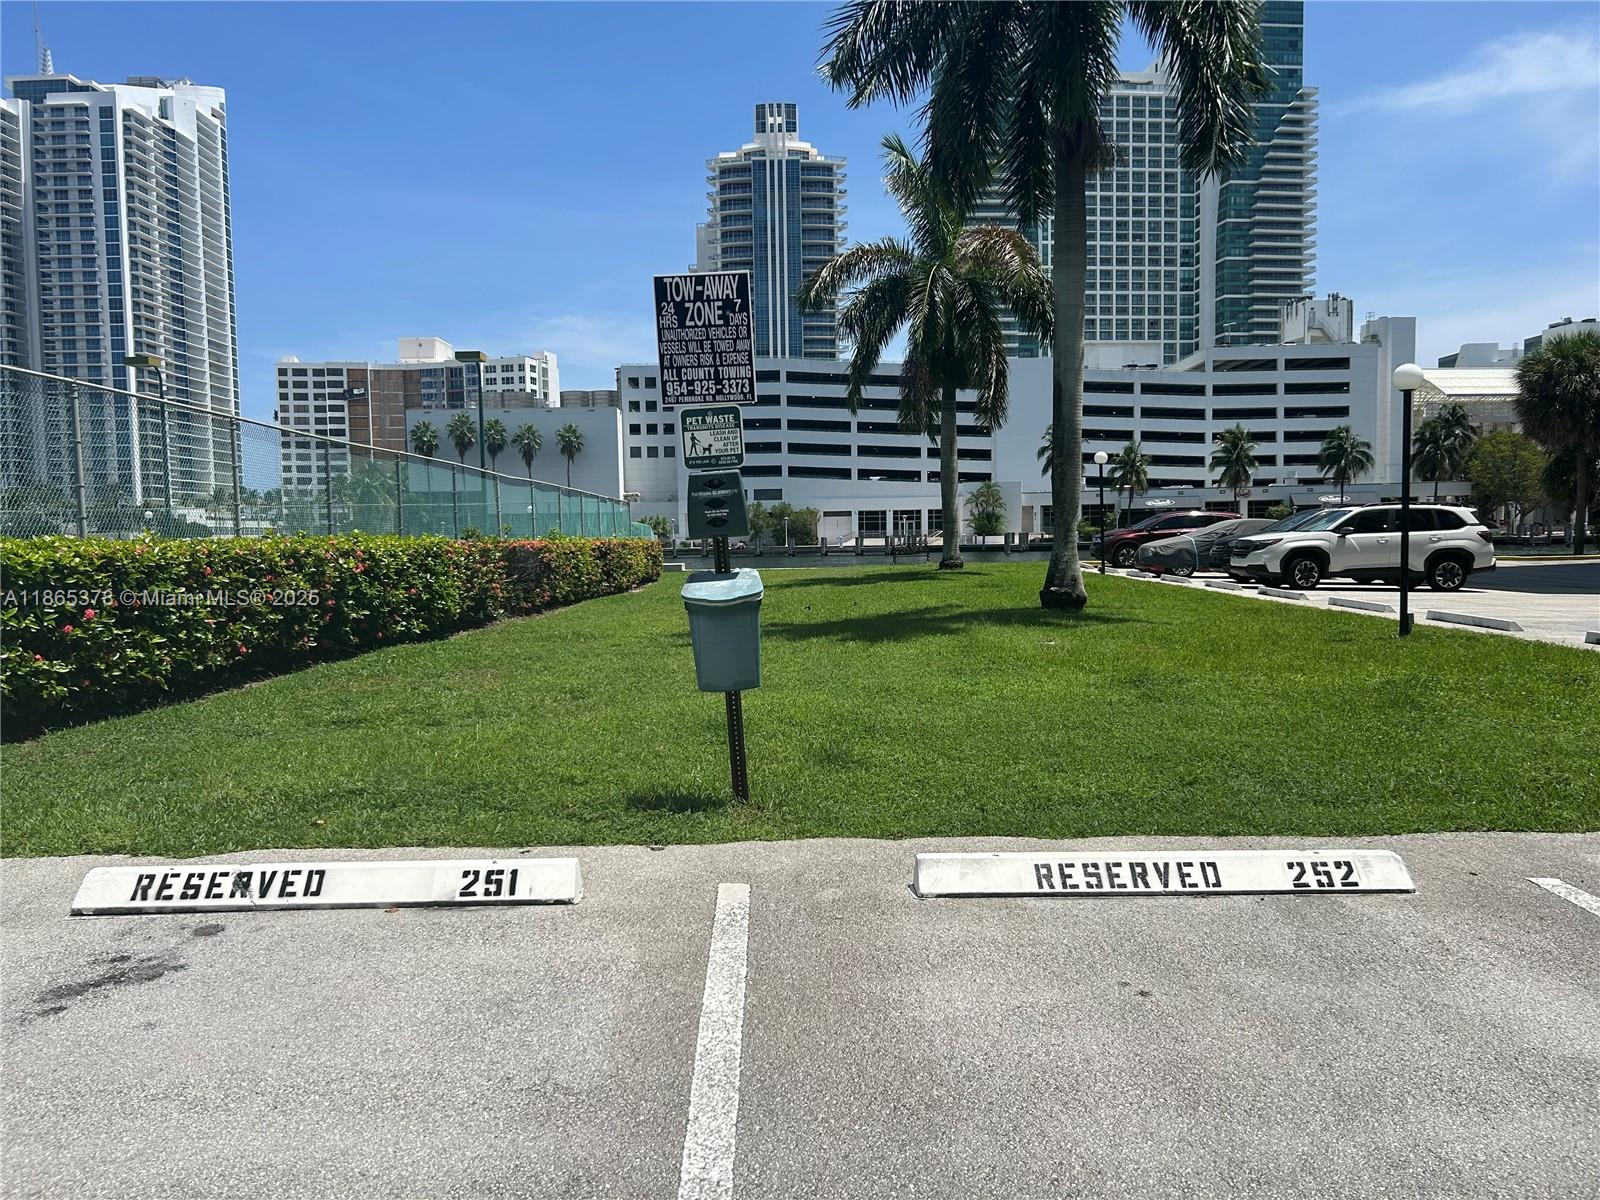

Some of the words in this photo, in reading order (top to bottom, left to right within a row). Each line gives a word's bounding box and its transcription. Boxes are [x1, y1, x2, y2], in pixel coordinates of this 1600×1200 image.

[663, 275, 739, 302] TOW-AWAY
[661, 302, 675, 316] 24
[733, 299, 742, 312] 7
[684, 301, 724, 327] ZONE
[729, 312, 748, 326] DAYS
[659, 315, 678, 329] HRS
[661, 327, 707, 341] UNAUTHORIZED
[708, 326, 737, 340] VEHICLES
[738, 326, 748, 338] OR
[660, 341, 687, 354] VESSELS
[688, 340, 703, 353] WILL
[703, 340, 712, 352] BE
[713, 340, 734, 352] TOWED
[735, 339, 751, 351] AWAY
[663, 355, 671, 367] AT
[672, 354, 699, 367] OWNERS
[700, 353, 715, 366] RISK
[715, 353, 721, 365] &
[722, 352, 750, 365] EXPENSE
[663, 369, 679, 381] ALL
[681, 367, 715, 380] COUNTY
[717, 365, 752, 379] TOWING
[666, 379, 750, 396] 954-925-3373
[678, 395, 705, 403] PEMBROKE
[686, 416, 703, 425] PET
[705, 414, 735, 424] WASTE
[1033, 861, 1223, 891] RESERVED
[1286, 860, 1360, 888] 252
[129, 868, 327, 902] RESERVED
[458, 868, 520, 898] 251
